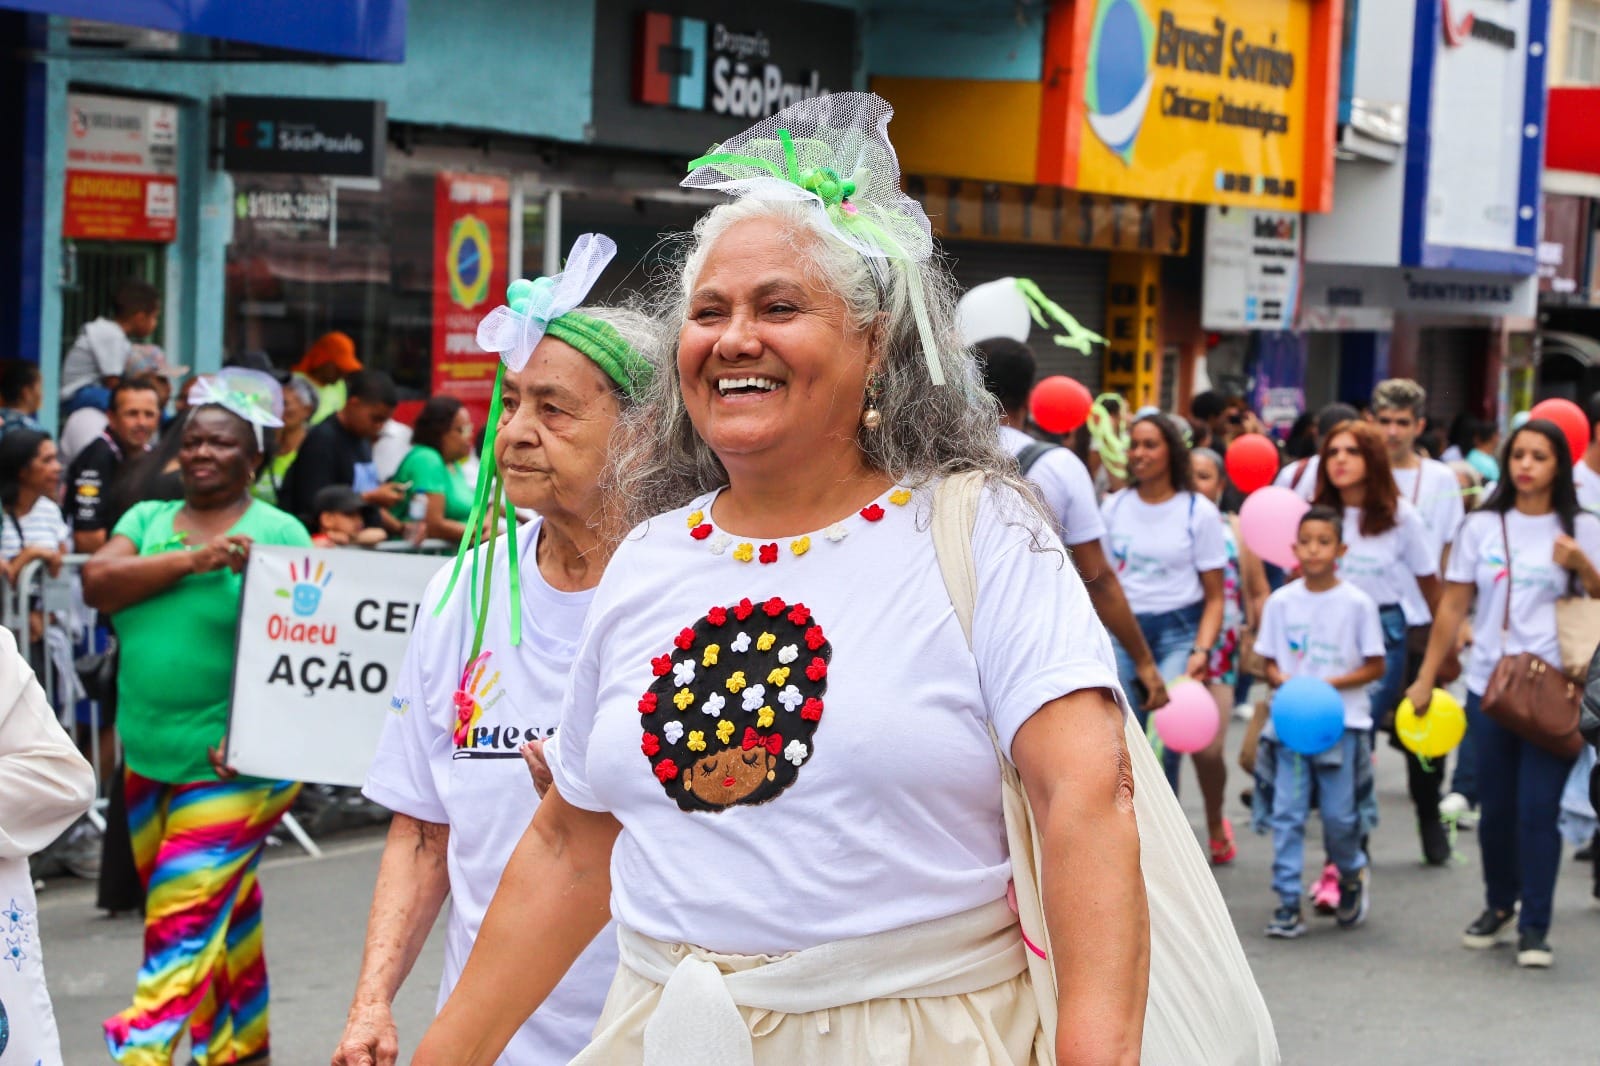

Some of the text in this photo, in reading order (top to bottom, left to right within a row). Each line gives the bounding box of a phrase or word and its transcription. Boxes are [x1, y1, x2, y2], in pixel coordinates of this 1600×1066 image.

[1156, 9, 1294, 89] Brasil Sorriso
[712, 56, 830, 117] SãoPaul
[267, 613, 337, 645] Oiaeu
[354, 599, 421, 633] CE
[266, 651, 388, 697] AÇÃO
[456, 724, 558, 749] rtes
